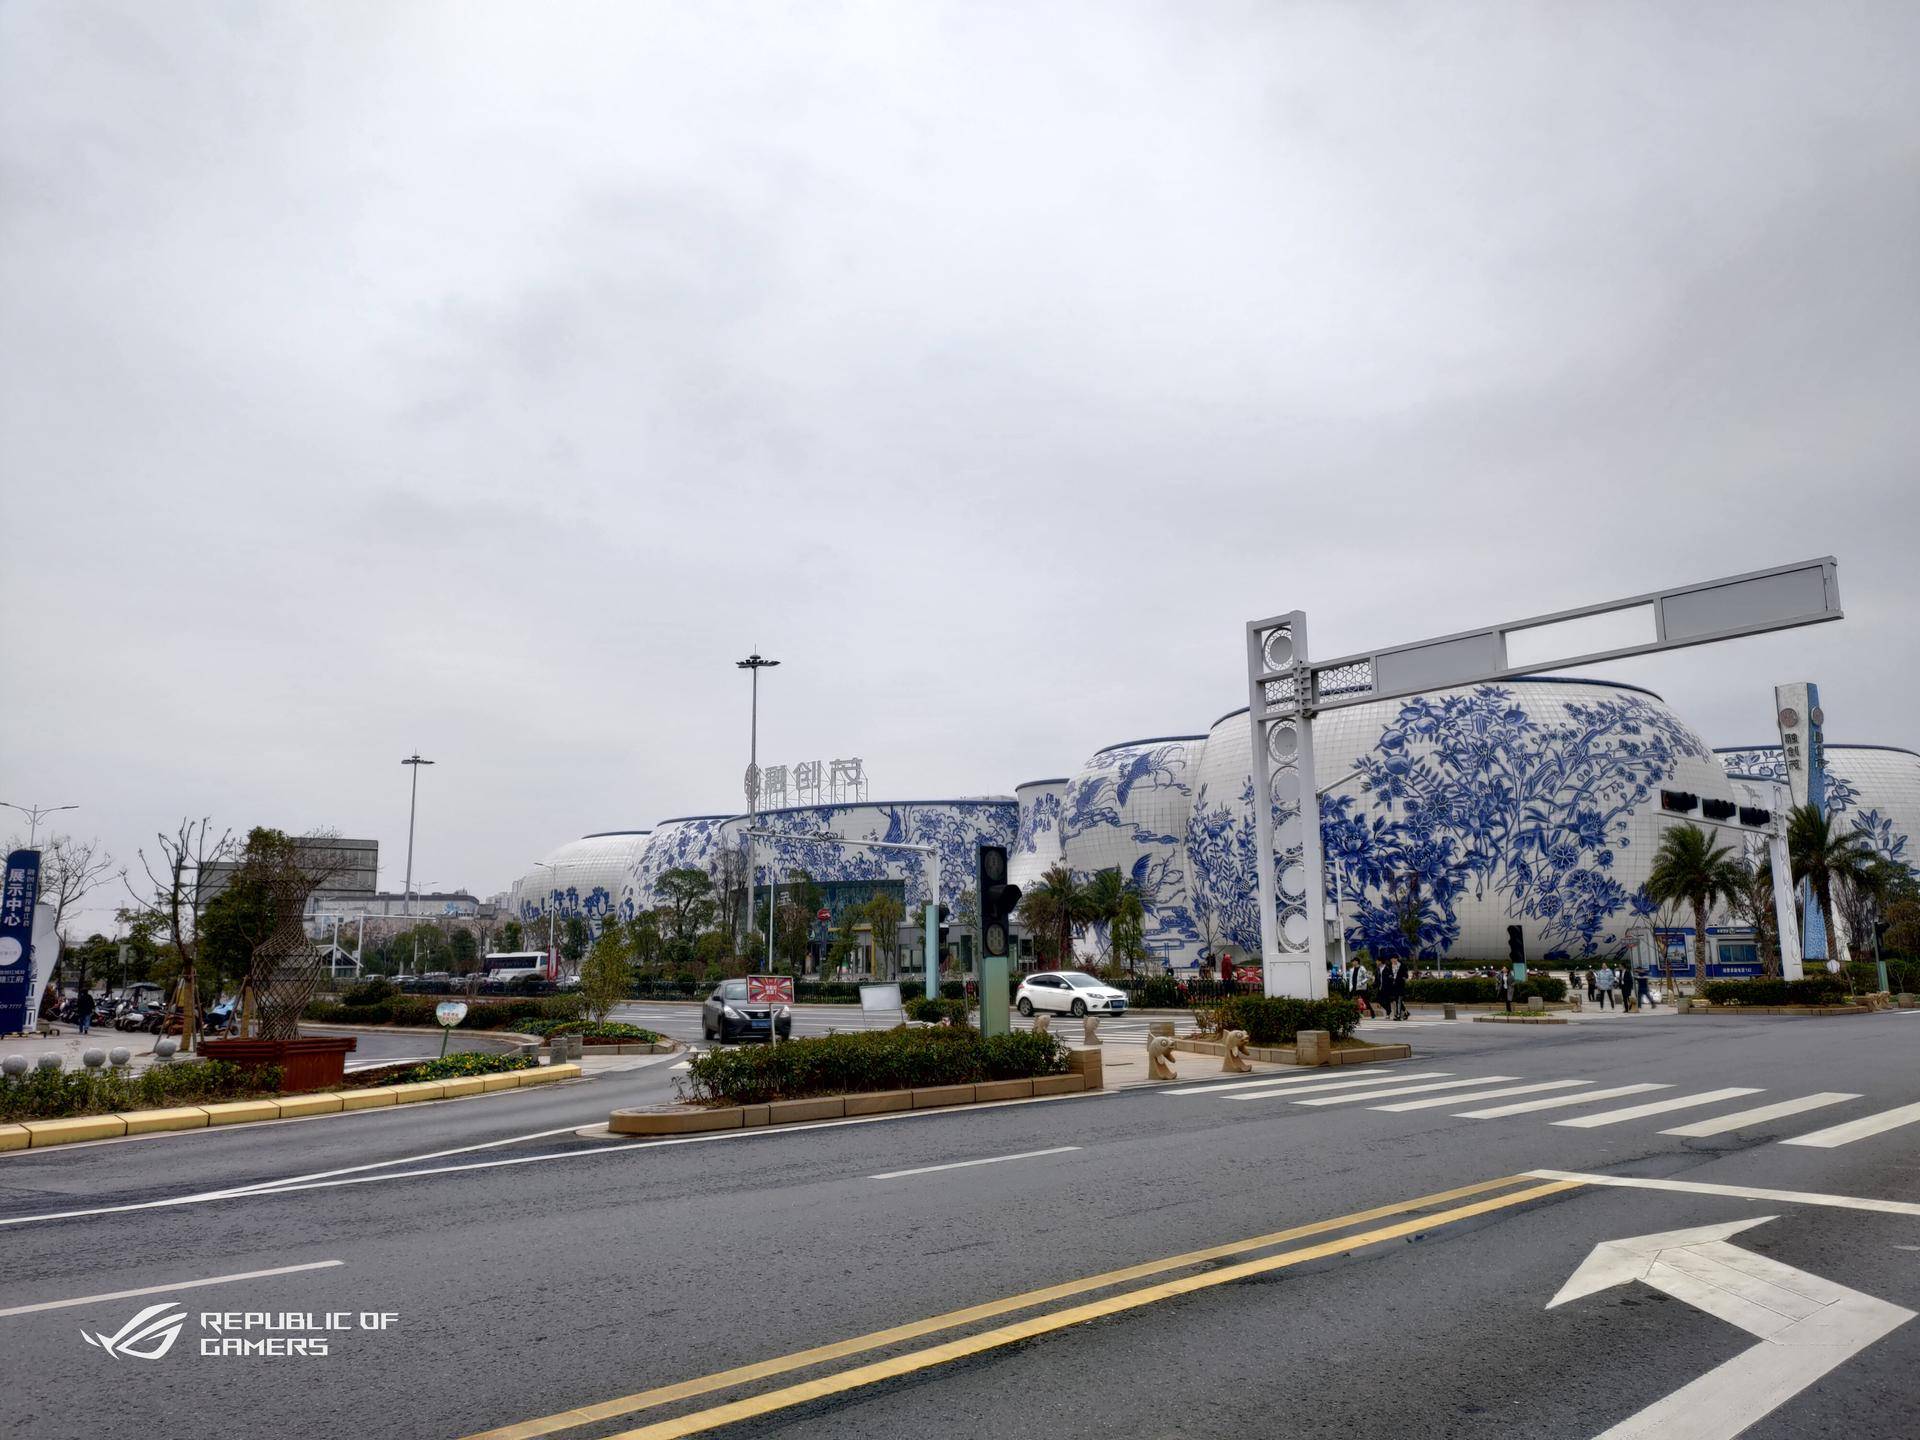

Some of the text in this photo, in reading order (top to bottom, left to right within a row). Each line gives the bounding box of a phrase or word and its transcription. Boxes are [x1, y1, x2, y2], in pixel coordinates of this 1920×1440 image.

[1784, 733, 1801, 771] 融创茂
[4, 868, 25, 927] 展示中心
